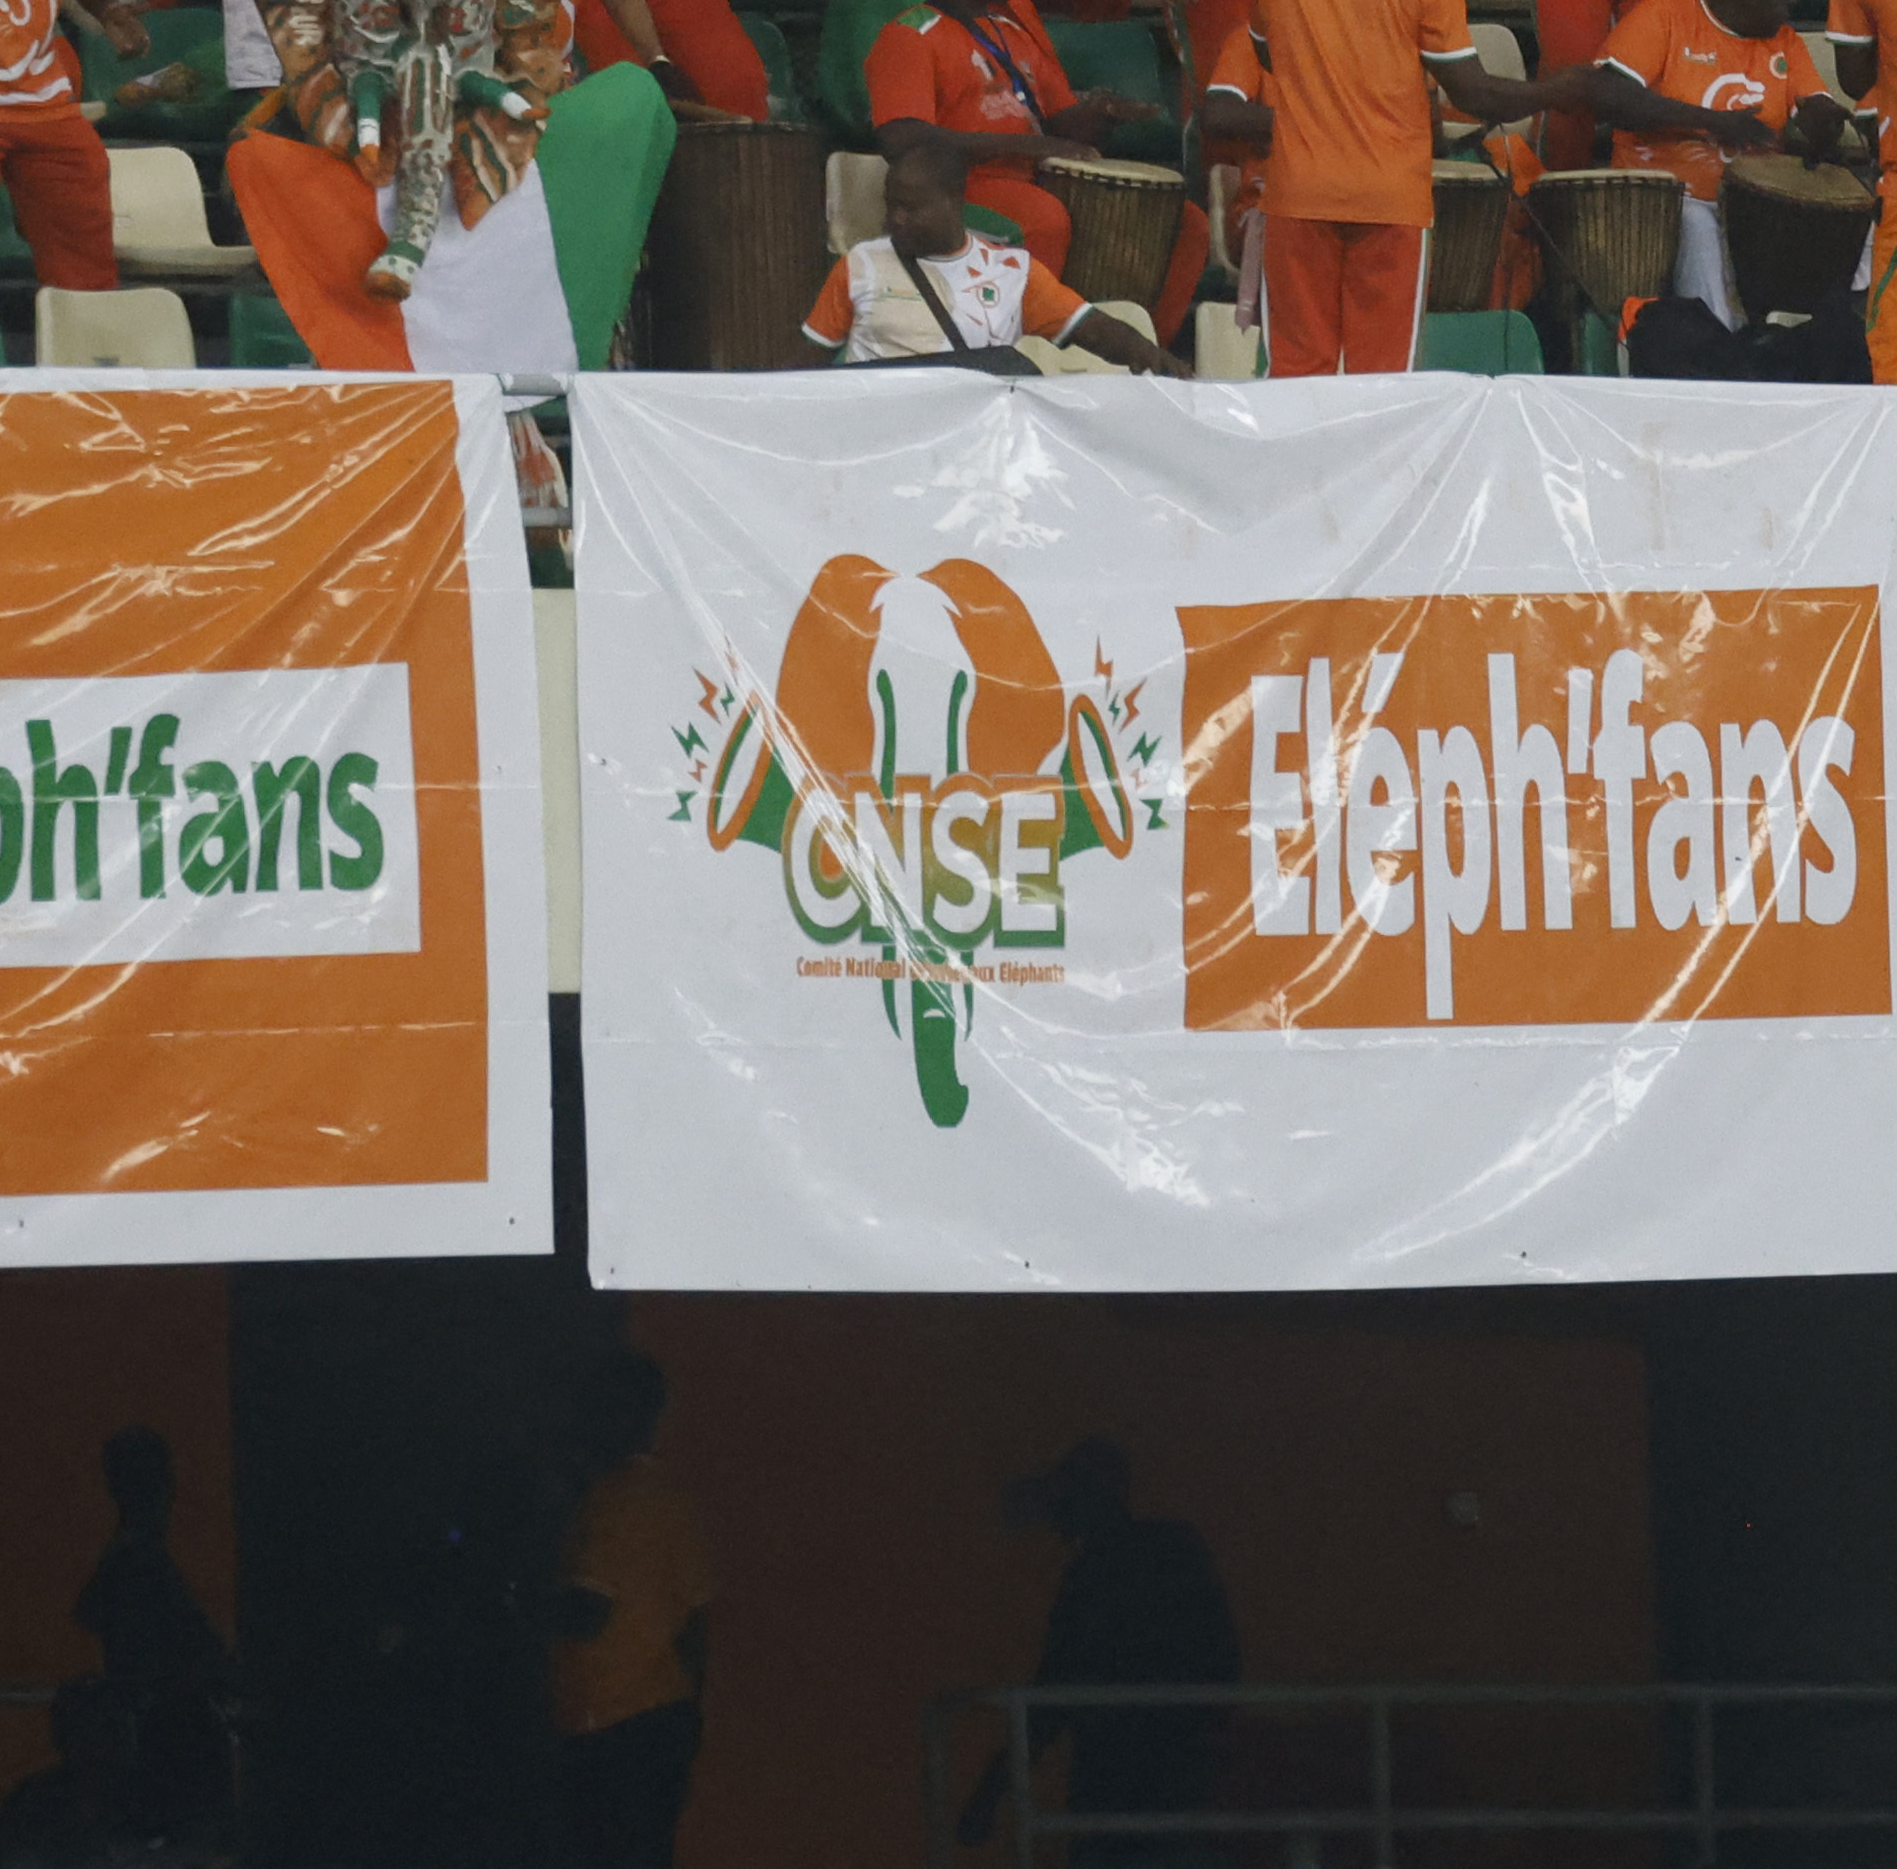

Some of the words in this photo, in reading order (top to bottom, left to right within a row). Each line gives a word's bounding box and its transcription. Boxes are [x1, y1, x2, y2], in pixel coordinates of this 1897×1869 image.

[791, 788, 1057, 934] CNSE
[1249, 649, 1857, 1020] Eléph'fans
[796, 955, 843, 978] Comité
